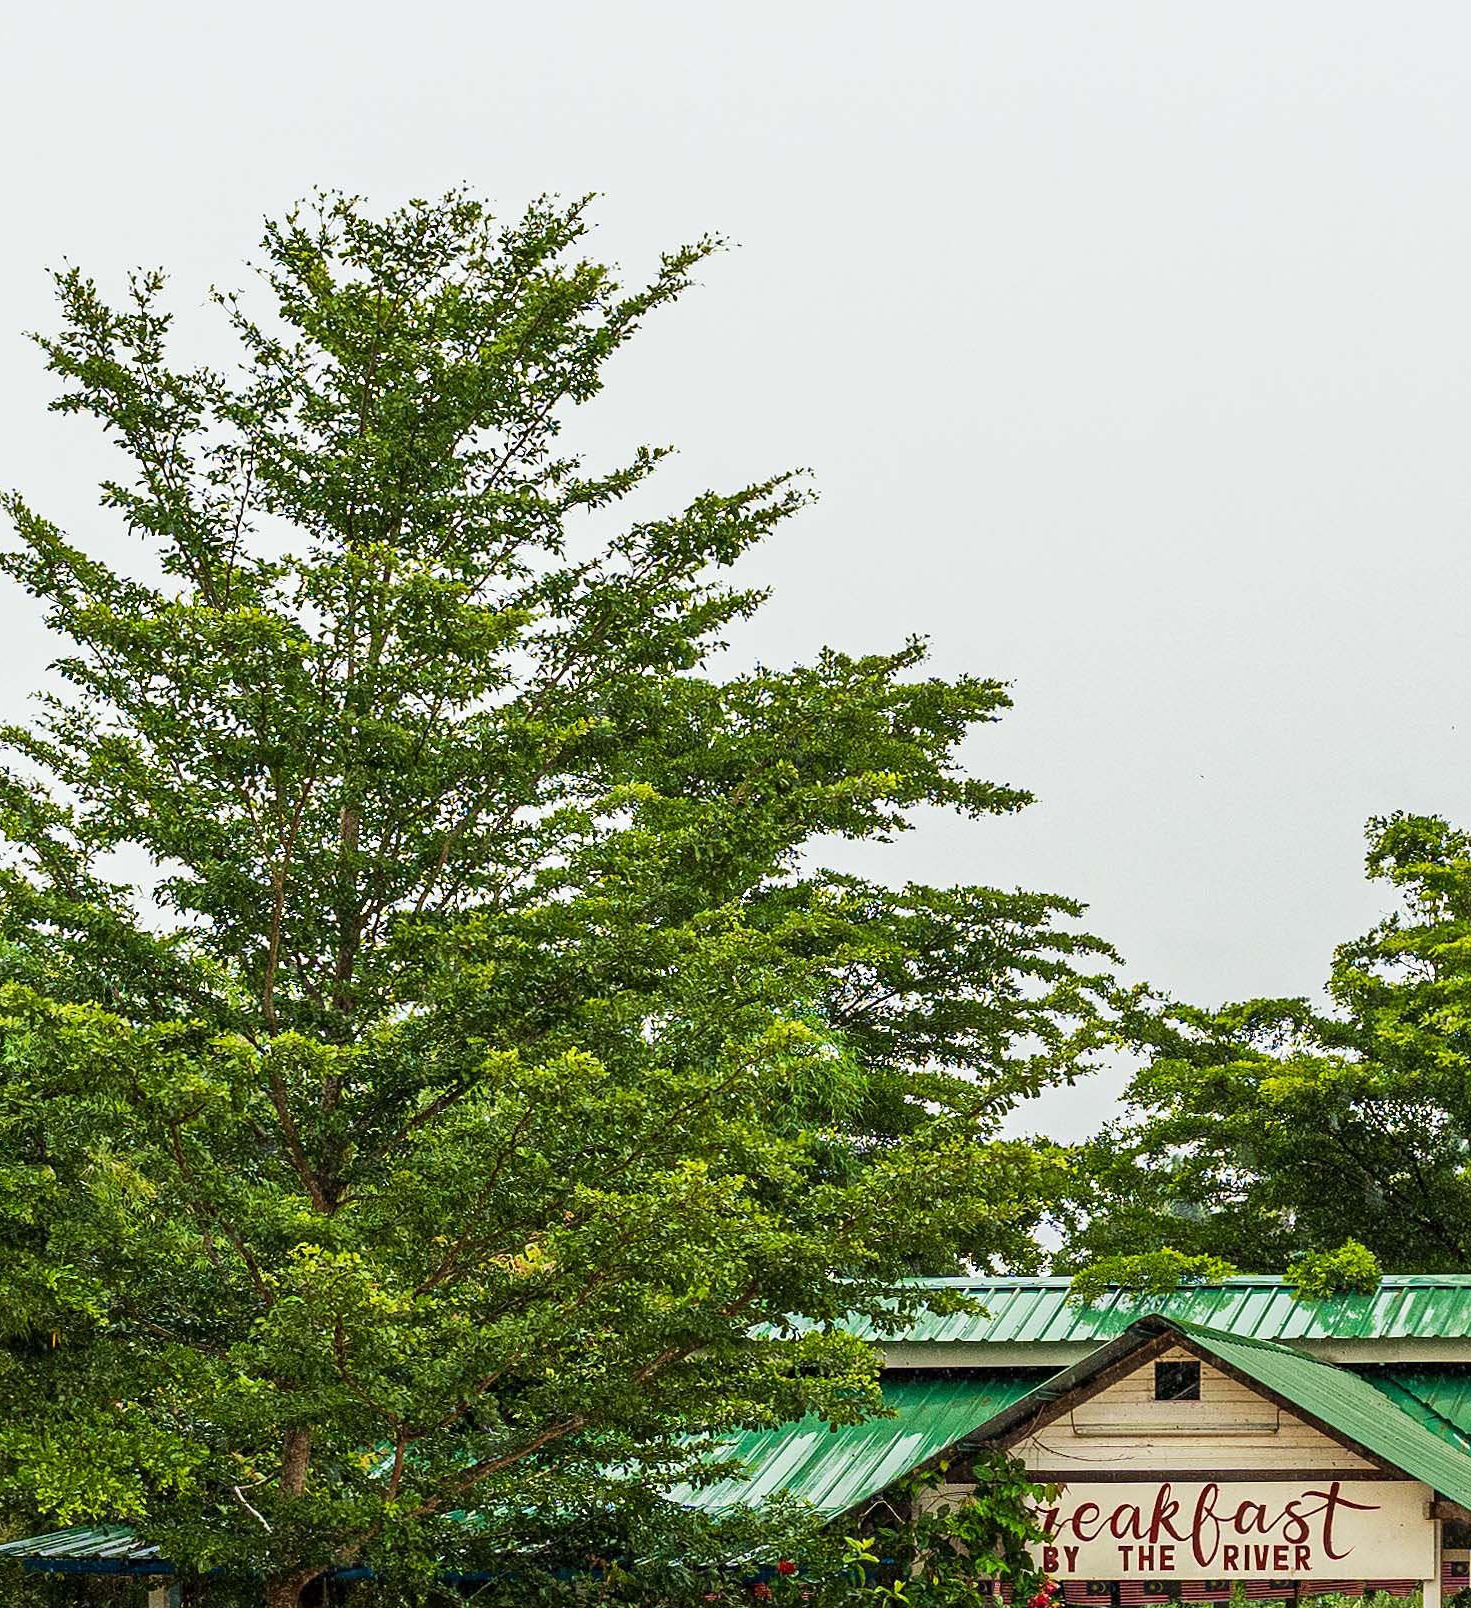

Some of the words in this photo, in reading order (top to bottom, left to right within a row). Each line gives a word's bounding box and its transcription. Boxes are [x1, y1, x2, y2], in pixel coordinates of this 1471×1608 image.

[1034, 1481, 1381, 1568] reakfast
[1042, 1545, 1080, 1573] BY
[1118, 1545, 1175, 1572] THE
[1223, 1544, 1313, 1571] RIVER
